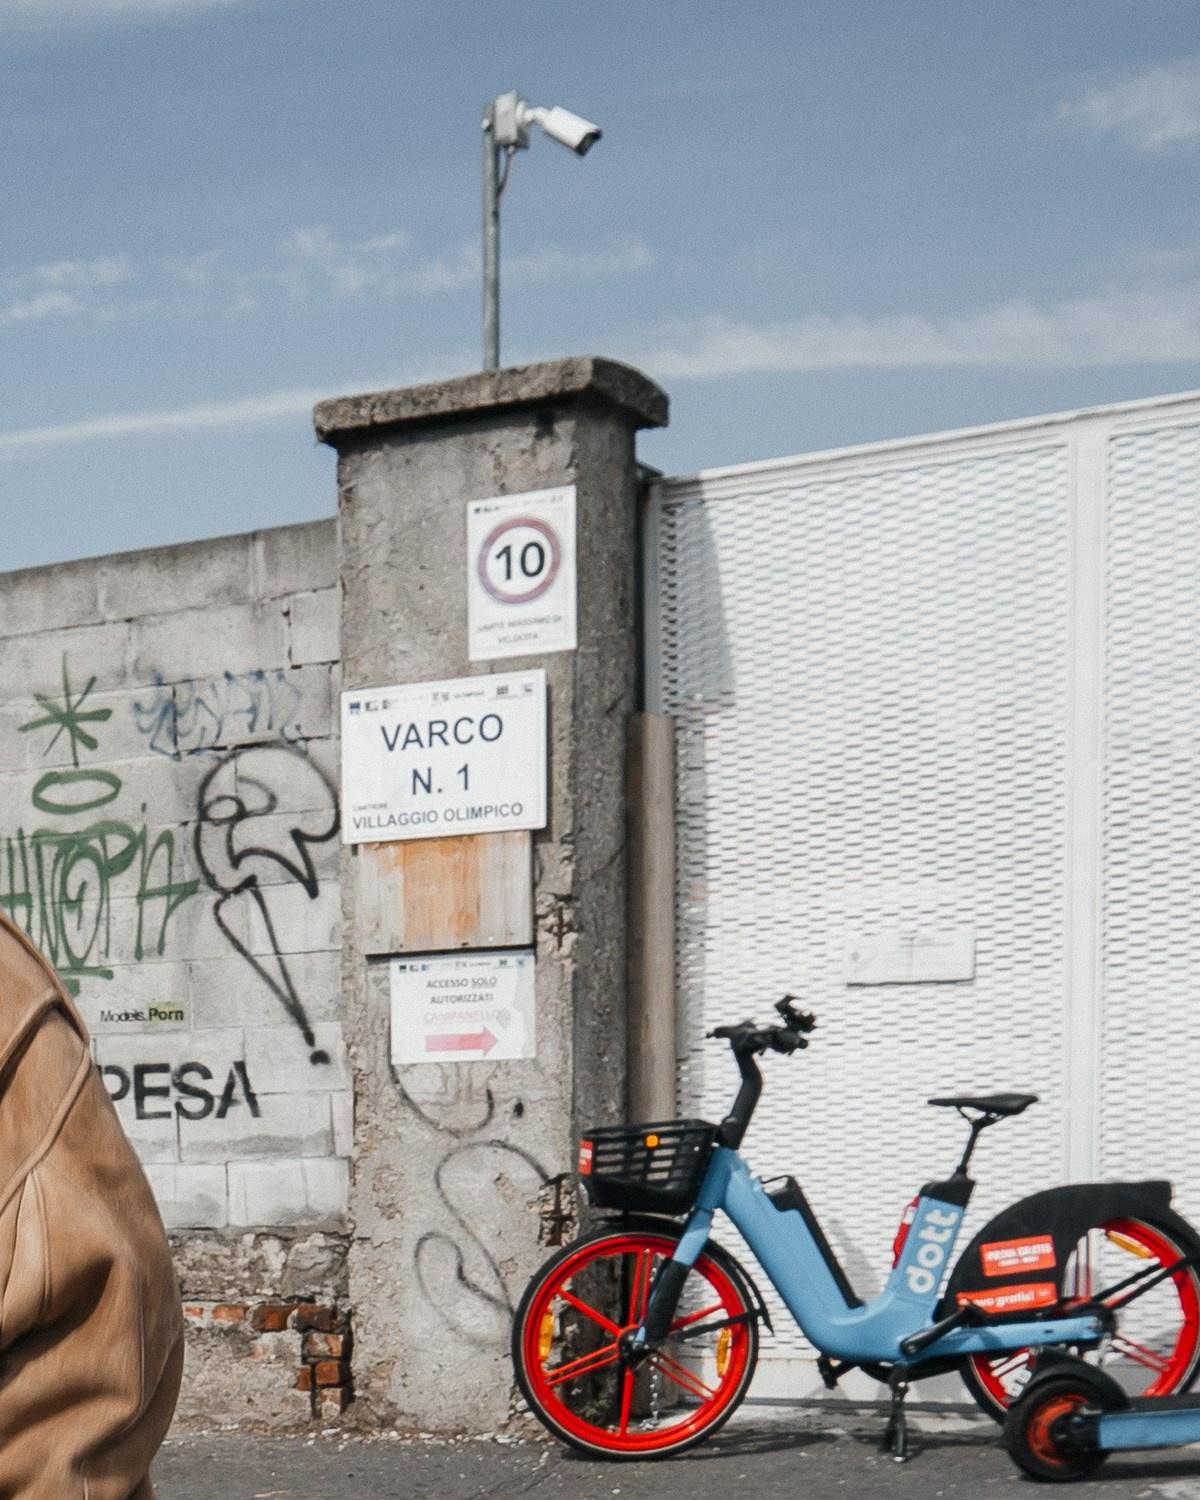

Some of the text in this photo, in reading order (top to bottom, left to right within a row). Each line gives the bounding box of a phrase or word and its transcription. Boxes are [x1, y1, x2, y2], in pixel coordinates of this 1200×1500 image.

[495, 541, 545, 581] 10
[381, 713, 504, 752] VARCO
[412, 763, 469, 795] N. 1
[353, 802, 523, 829] VILLAGGIO OLIMPICO
[426, 976, 498, 989] ACCESSO SOLO
[430, 993, 494, 1004] AUTORIZZATI
[905, 1208, 960, 1295] dott
